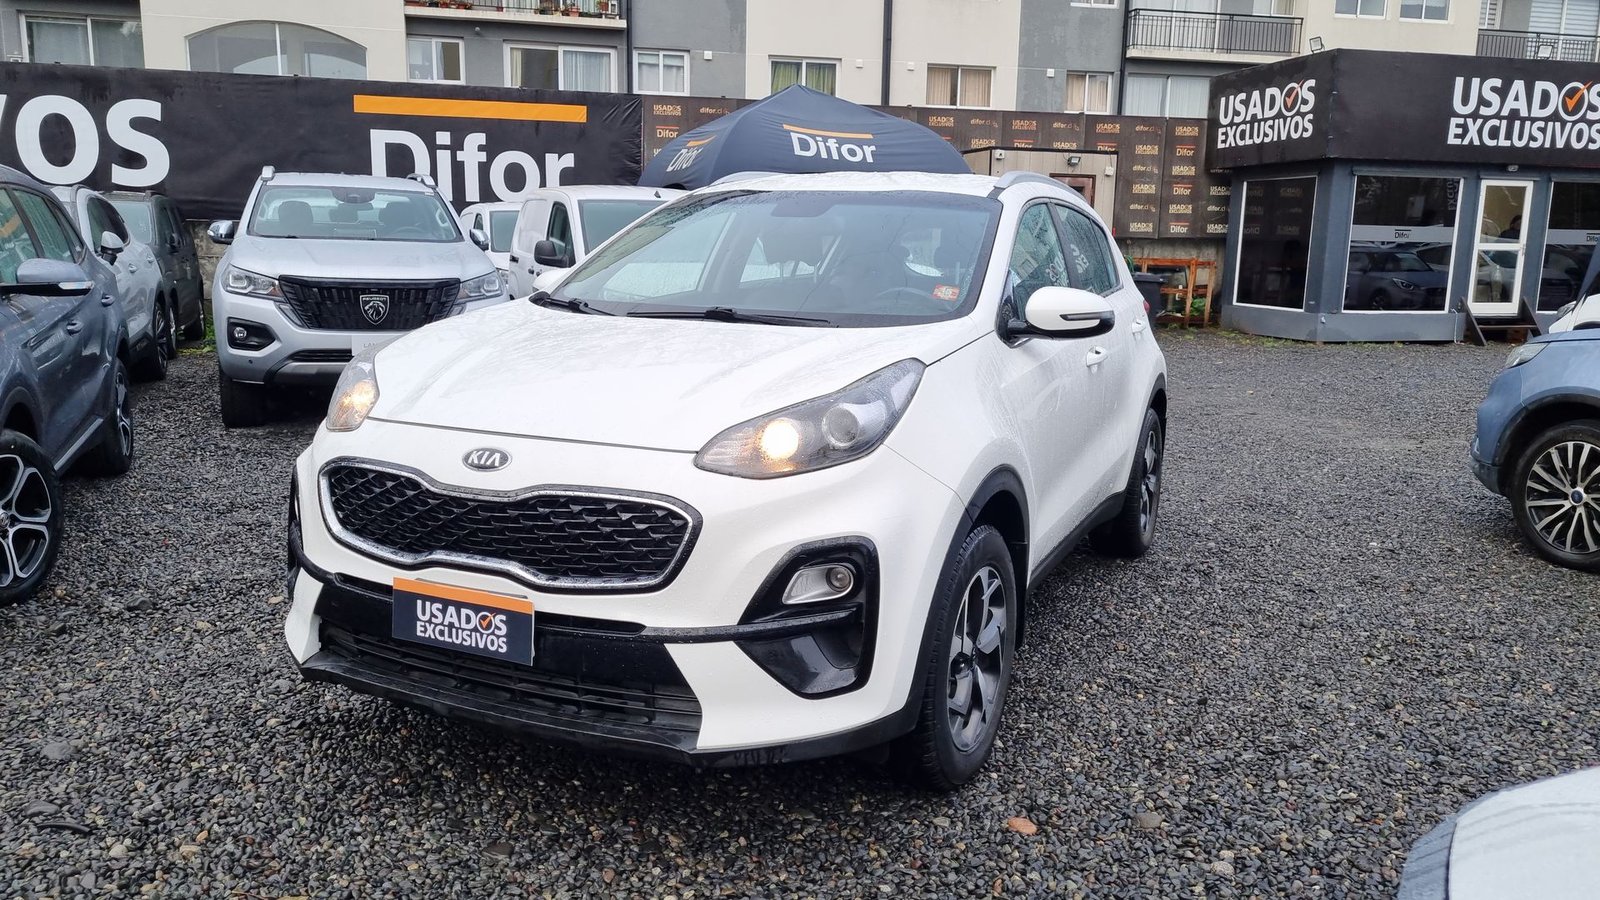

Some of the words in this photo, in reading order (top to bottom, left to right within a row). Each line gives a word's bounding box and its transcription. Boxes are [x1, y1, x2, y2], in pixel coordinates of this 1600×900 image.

[1219, 79, 1316, 125] USADOS
[1453, 77, 1600, 121] USADOS
[0, 94, 170, 187] OS
[657, 129, 678, 138] Difor
[790, 132, 876, 163] Difor
[1217, 114, 1313, 149] EXCLUSIVOS
[1447, 117, 1600, 150] EXCLUSIVOS
[370, 129, 574, 202] Difor
[1176, 148, 1194, 156] Difor
[1173, 187, 1191, 195] Difor
[1170, 225, 1188, 233] Difor
[467, 450, 501, 467] KIA
[416, 599, 507, 636] USADOS
[416, 621, 507, 653] EXCLUSIVOS
